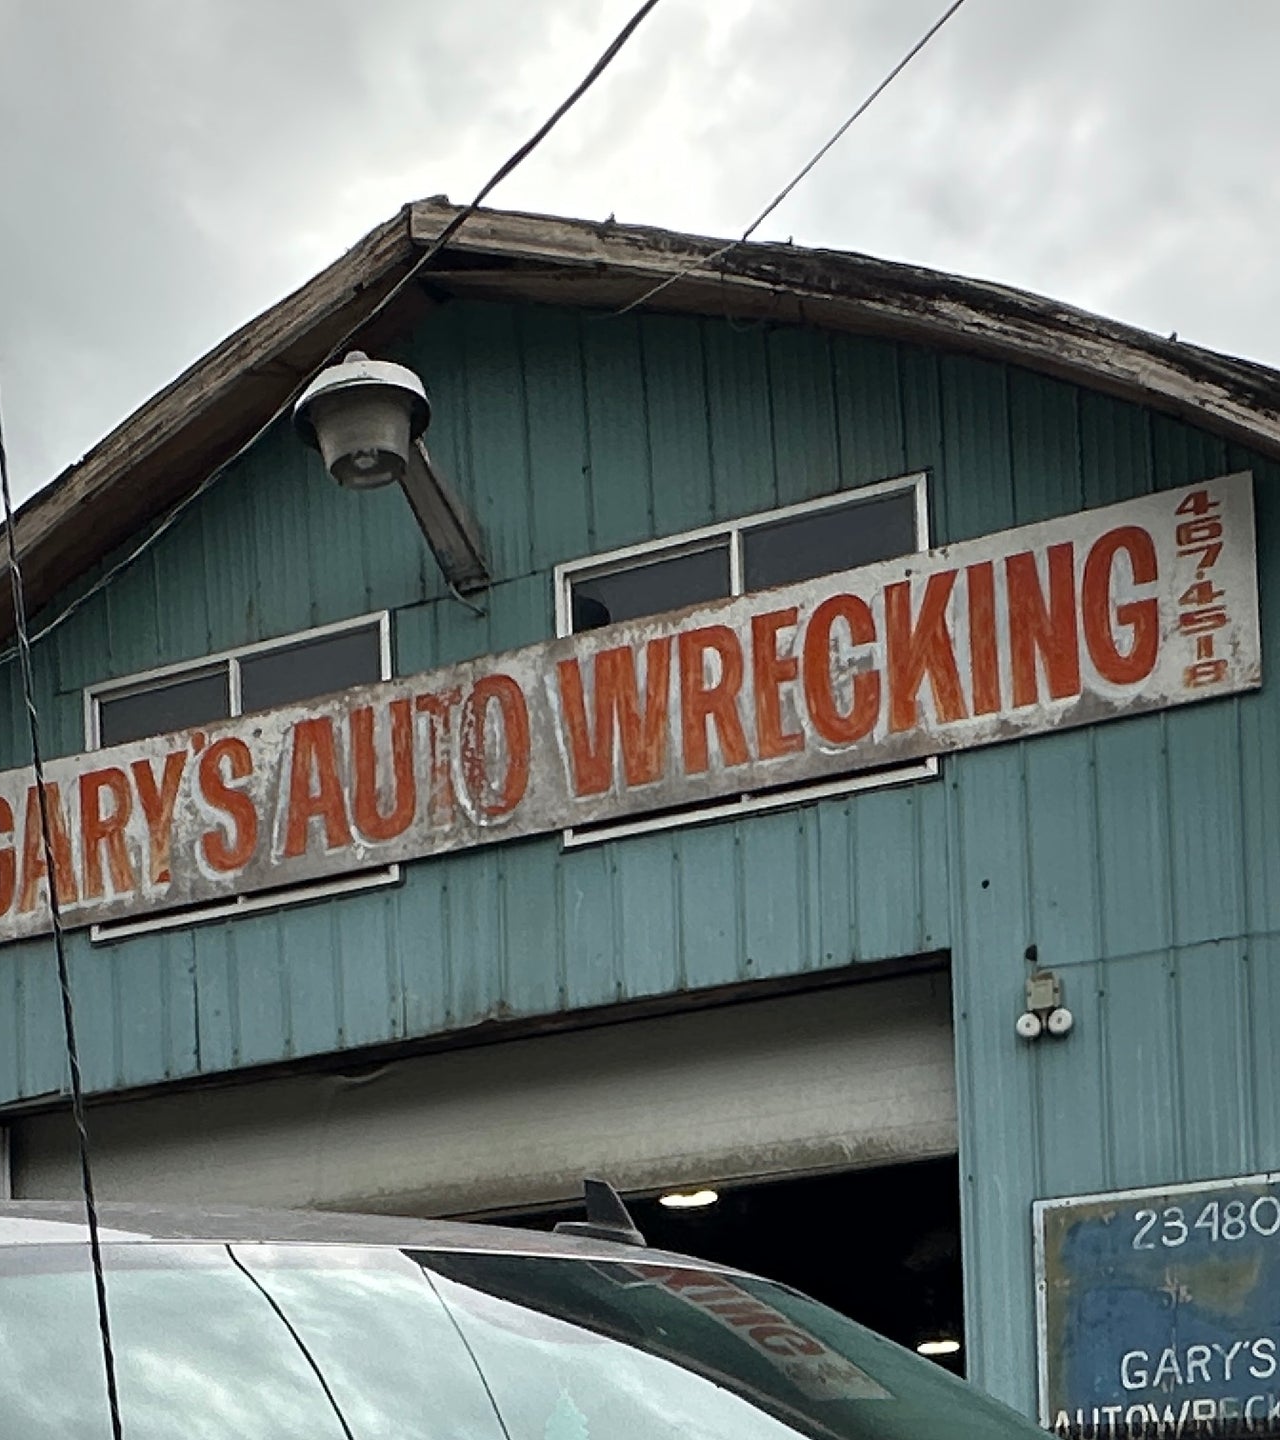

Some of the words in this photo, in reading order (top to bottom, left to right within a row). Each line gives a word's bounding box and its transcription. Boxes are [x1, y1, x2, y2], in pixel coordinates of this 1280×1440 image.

[281, 675, 531, 858] AUTO
[557, 526, 1159, 797] WRECKING
[1120, 1337, 1277, 1390] GARY'S
